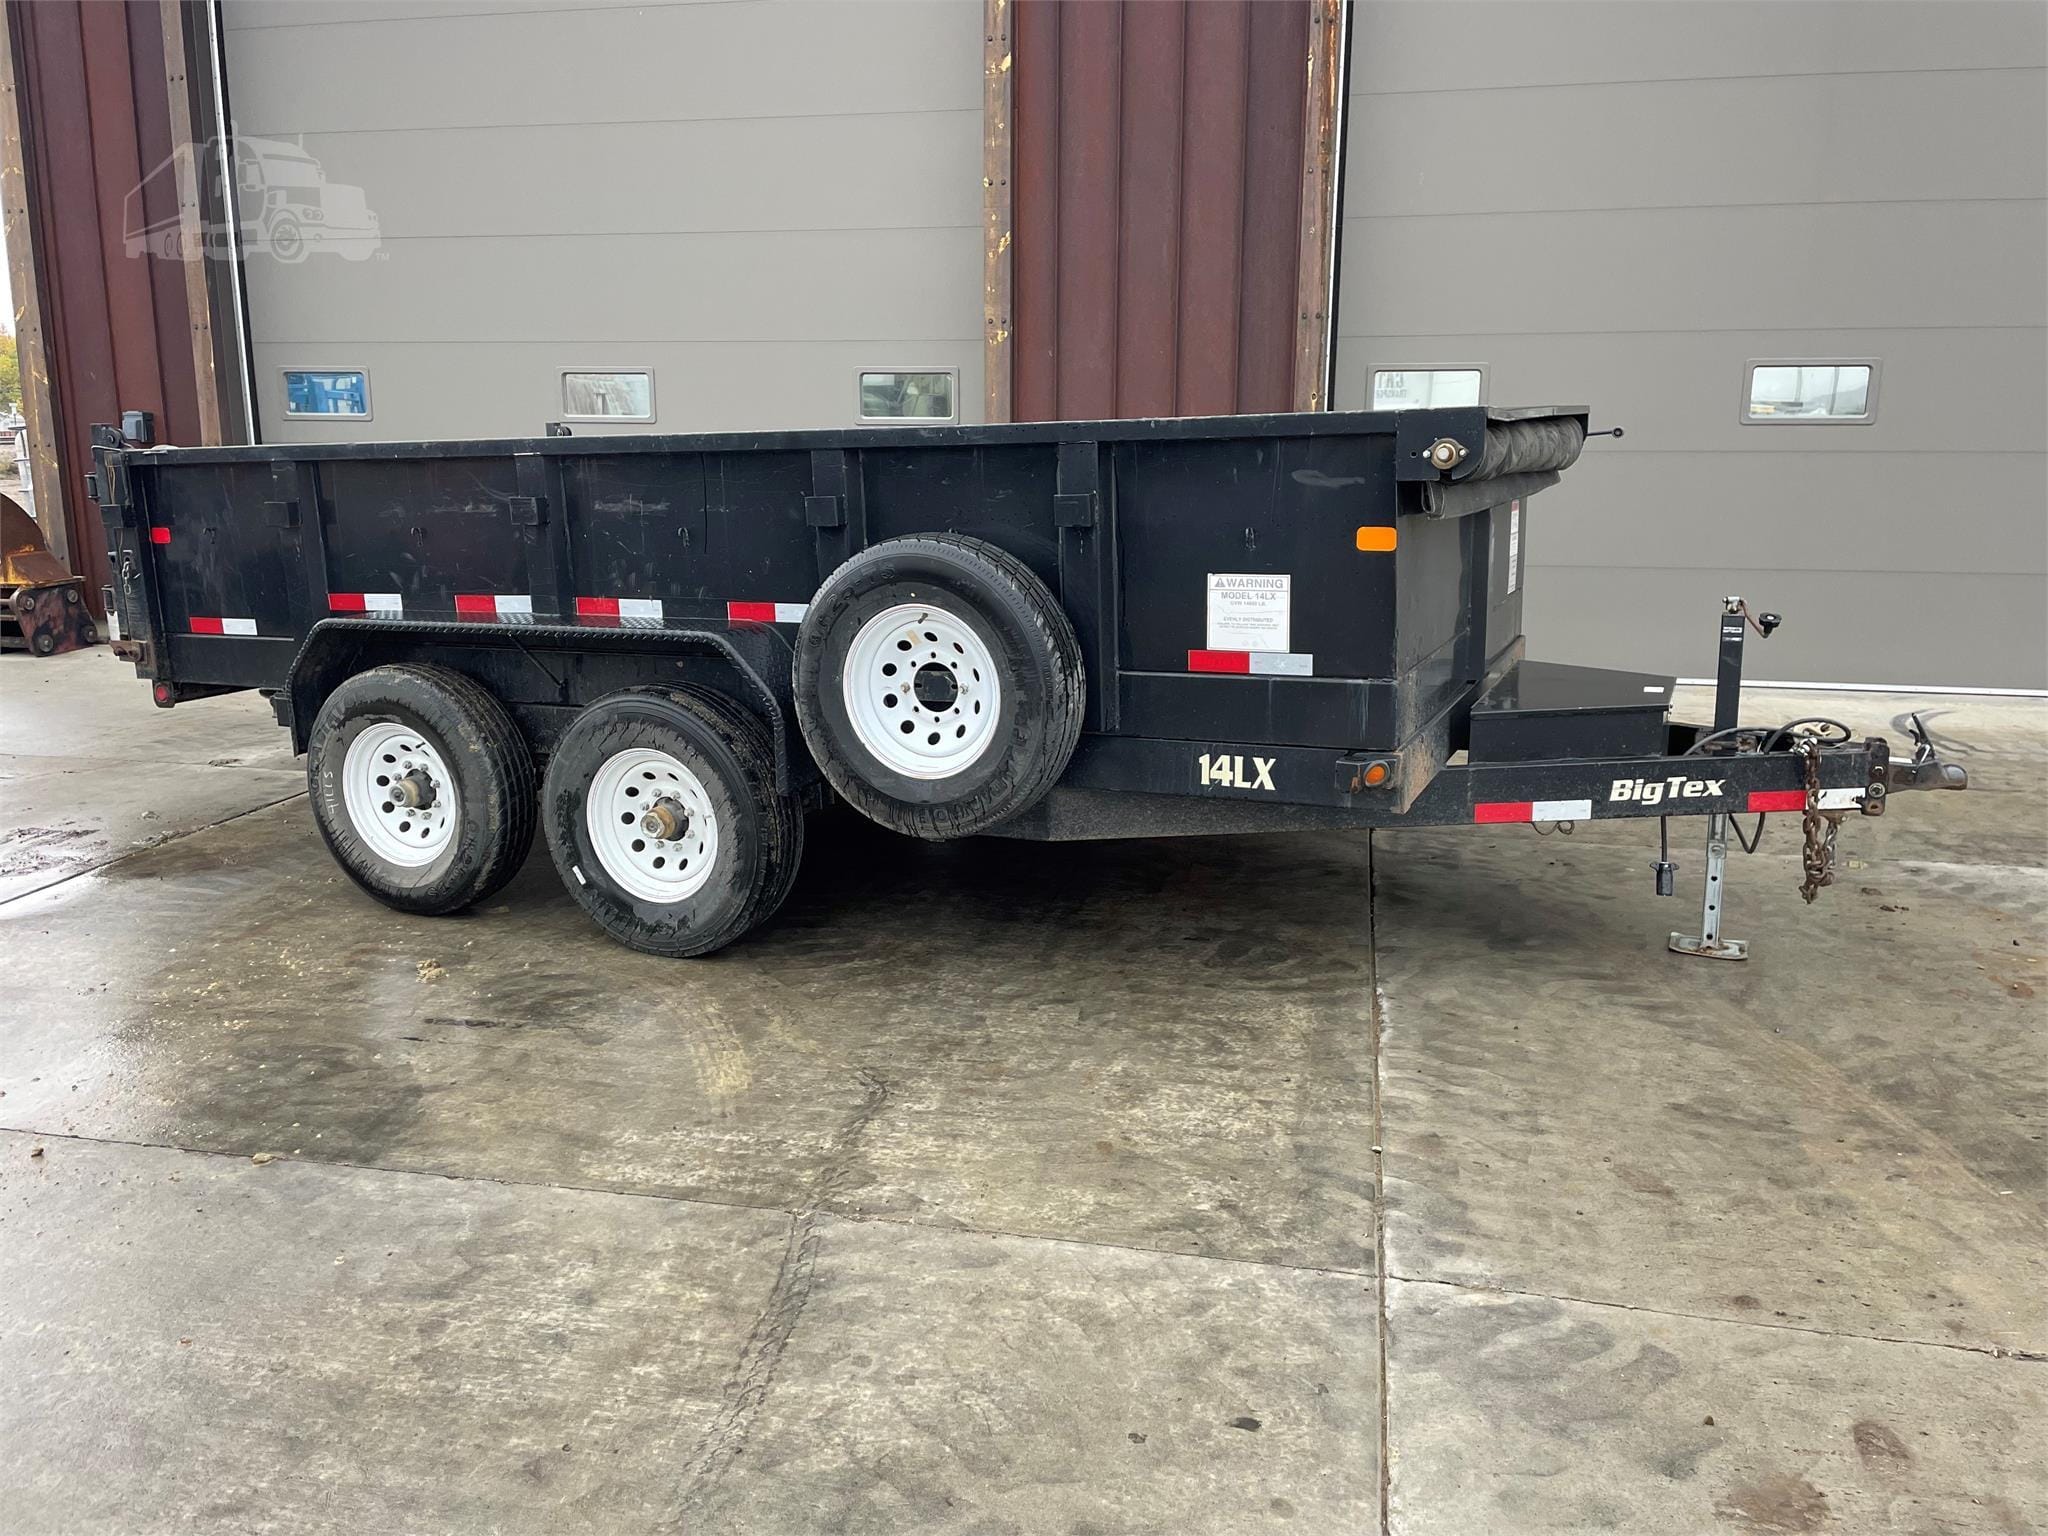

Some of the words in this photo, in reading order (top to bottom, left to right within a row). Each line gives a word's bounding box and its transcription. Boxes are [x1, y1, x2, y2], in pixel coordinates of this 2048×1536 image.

[1226, 578, 1284, 589] WARNING
[1221, 592, 1252, 600] MODEL
[1255, 592, 1277, 601] 14LX
[1199, 753, 1277, 791] 14LX
